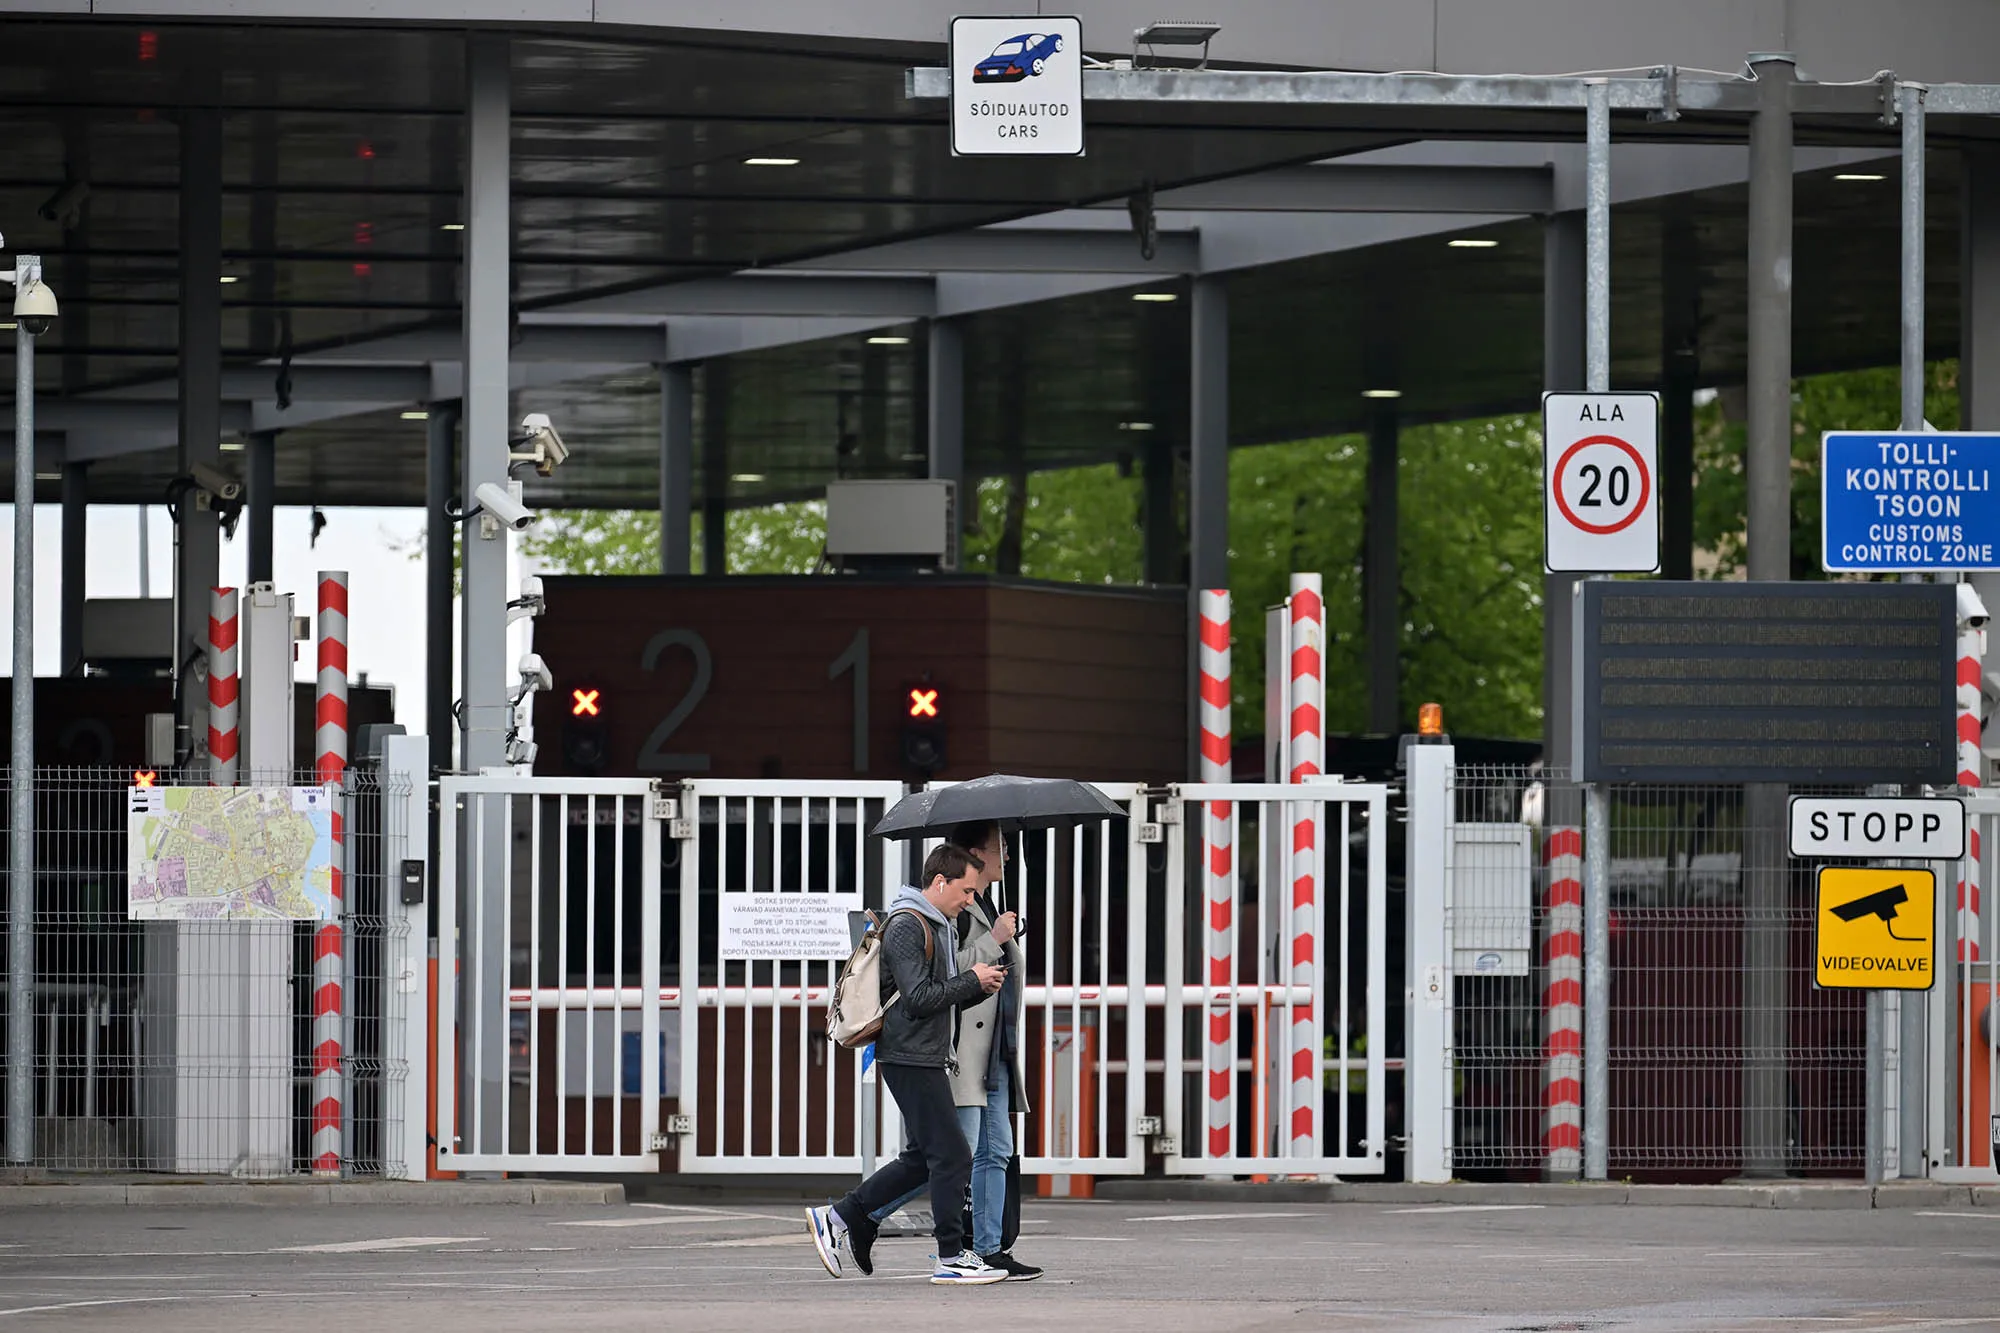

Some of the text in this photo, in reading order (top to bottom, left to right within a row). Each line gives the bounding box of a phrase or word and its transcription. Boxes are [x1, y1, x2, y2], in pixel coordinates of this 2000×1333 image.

[970, 100, 1069, 116] SÕIDUAUTOD
[998, 125, 1038, 138] CARS
[1579, 404, 1625, 422] ALA
[1878, 443, 1957, 465] TOLLI-
[1578, 464, 1630, 507] 20
[1846, 468, 1989, 491] KONTROLLI
[1875, 495, 1961, 517] TSOON
[1869, 524, 1963, 543] CUSTOMS
[1842, 544, 1993, 562] CONTROL ZONE
[637, 628, 712, 771] 2
[828, 626, 870, 772] 1
[1810, 811, 1941, 843] STOPP
[1821, 956, 1929, 972] VIDEOVALVE
